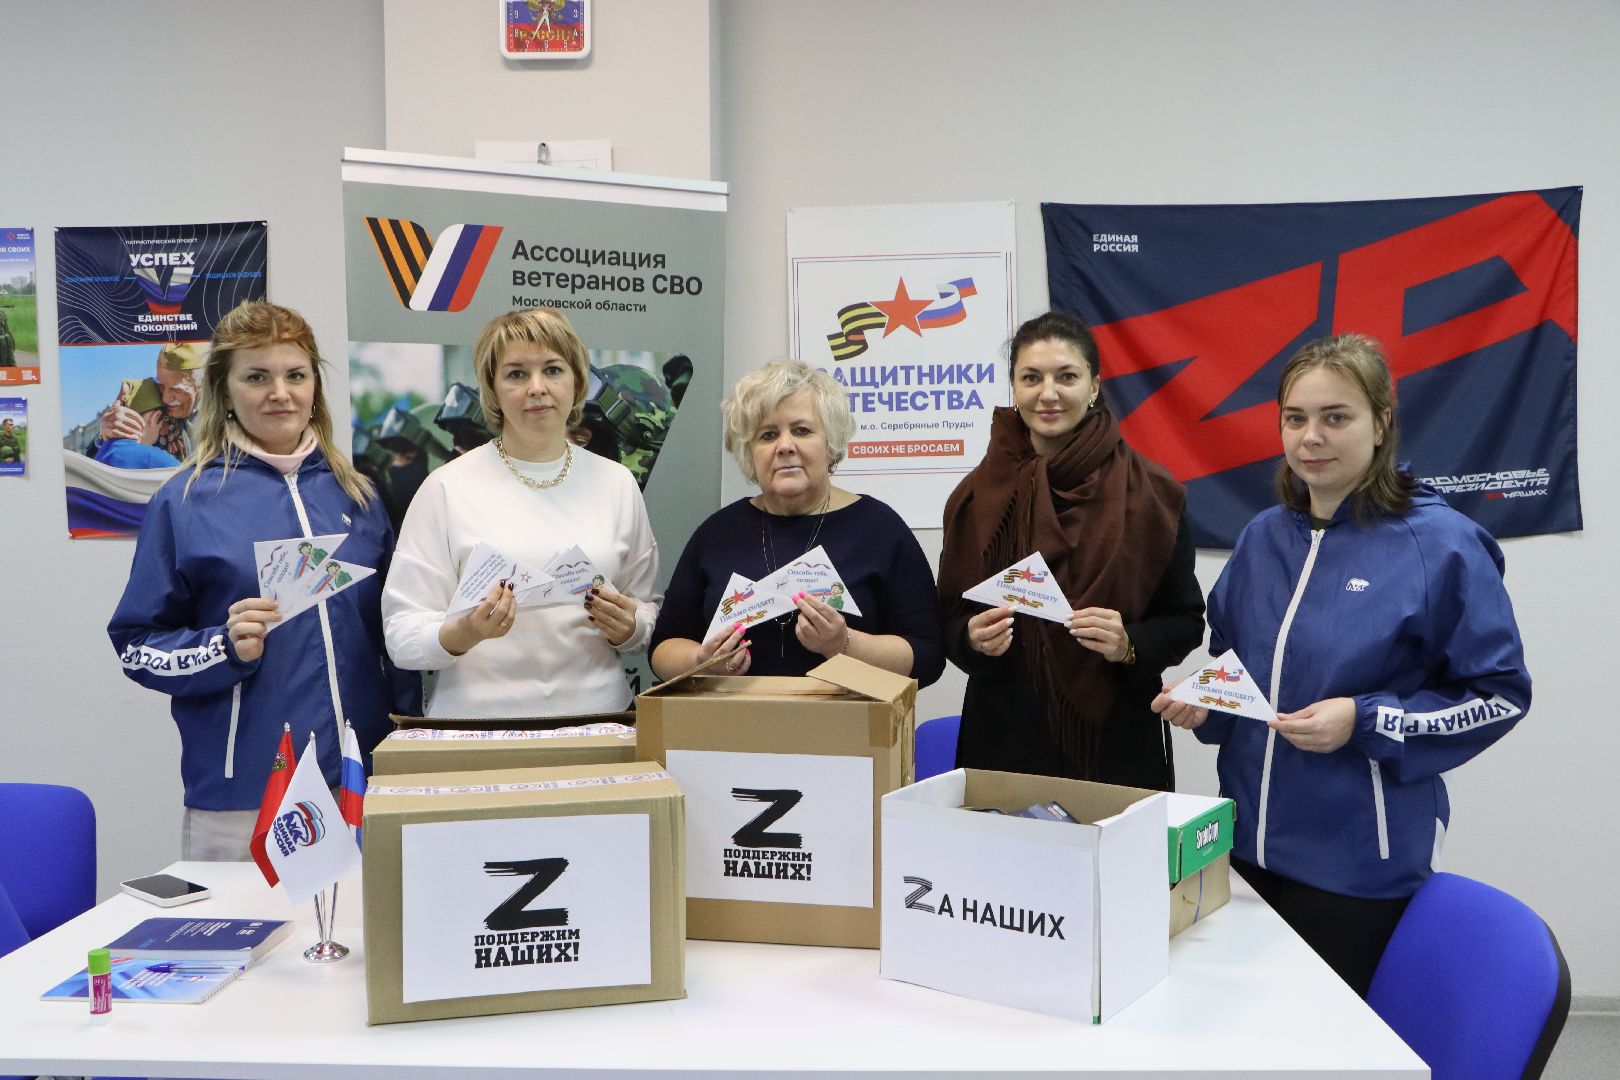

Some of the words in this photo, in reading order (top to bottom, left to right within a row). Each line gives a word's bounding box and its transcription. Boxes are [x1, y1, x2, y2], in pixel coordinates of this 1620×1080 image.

[1093, 233, 1138, 243] ЕДИНАЯ
[1093, 243, 1139, 252] РОССИЯ
[129, 252, 195, 267] УСПЕХ
[512, 240, 666, 269] Ассоциация
[512, 269, 645, 294] ветеранов
[652, 274, 703, 296] СВО
[512, 295, 592, 310] Московской
[595, 300, 647, 312] области
[133, 321, 198, 332] ПОКОЛЕНИЙ
[138, 313, 193, 323] ЕДИНСТВЕ
[846, 390, 984, 413] ТЕЧЕСТВА
[881, 421, 939, 431] Серебряные
[942, 420, 974, 430] Пруды
[852, 446, 889, 455] СВОИХ
[891, 445, 905, 454] НЕ
[907, 443, 960, 453] БРОСАЕМ
[1415, 468, 1550, 485] ОДМОСКОВЬЕ
[997, 580, 1026, 594] Письмо
[1027, 590, 1058, 604] солдату
[719, 605, 747, 622] Письмо
[747, 597, 775, 612] солдату
[1192, 681, 1222, 695] Письмо
[1224, 691, 1256, 703] солдату
[730, 787, 803, 848] Z
[723, 848, 812, 862] ПОДДЕРЖИМ
[723, 860, 812, 881] НАШИХ!
[483, 857, 569, 931] Z
[962, 897, 1066, 940] НАШИХ
[474, 928, 581, 947] ПОДДЕРЖИМ
[474, 942, 579, 969] НАШИХ!
